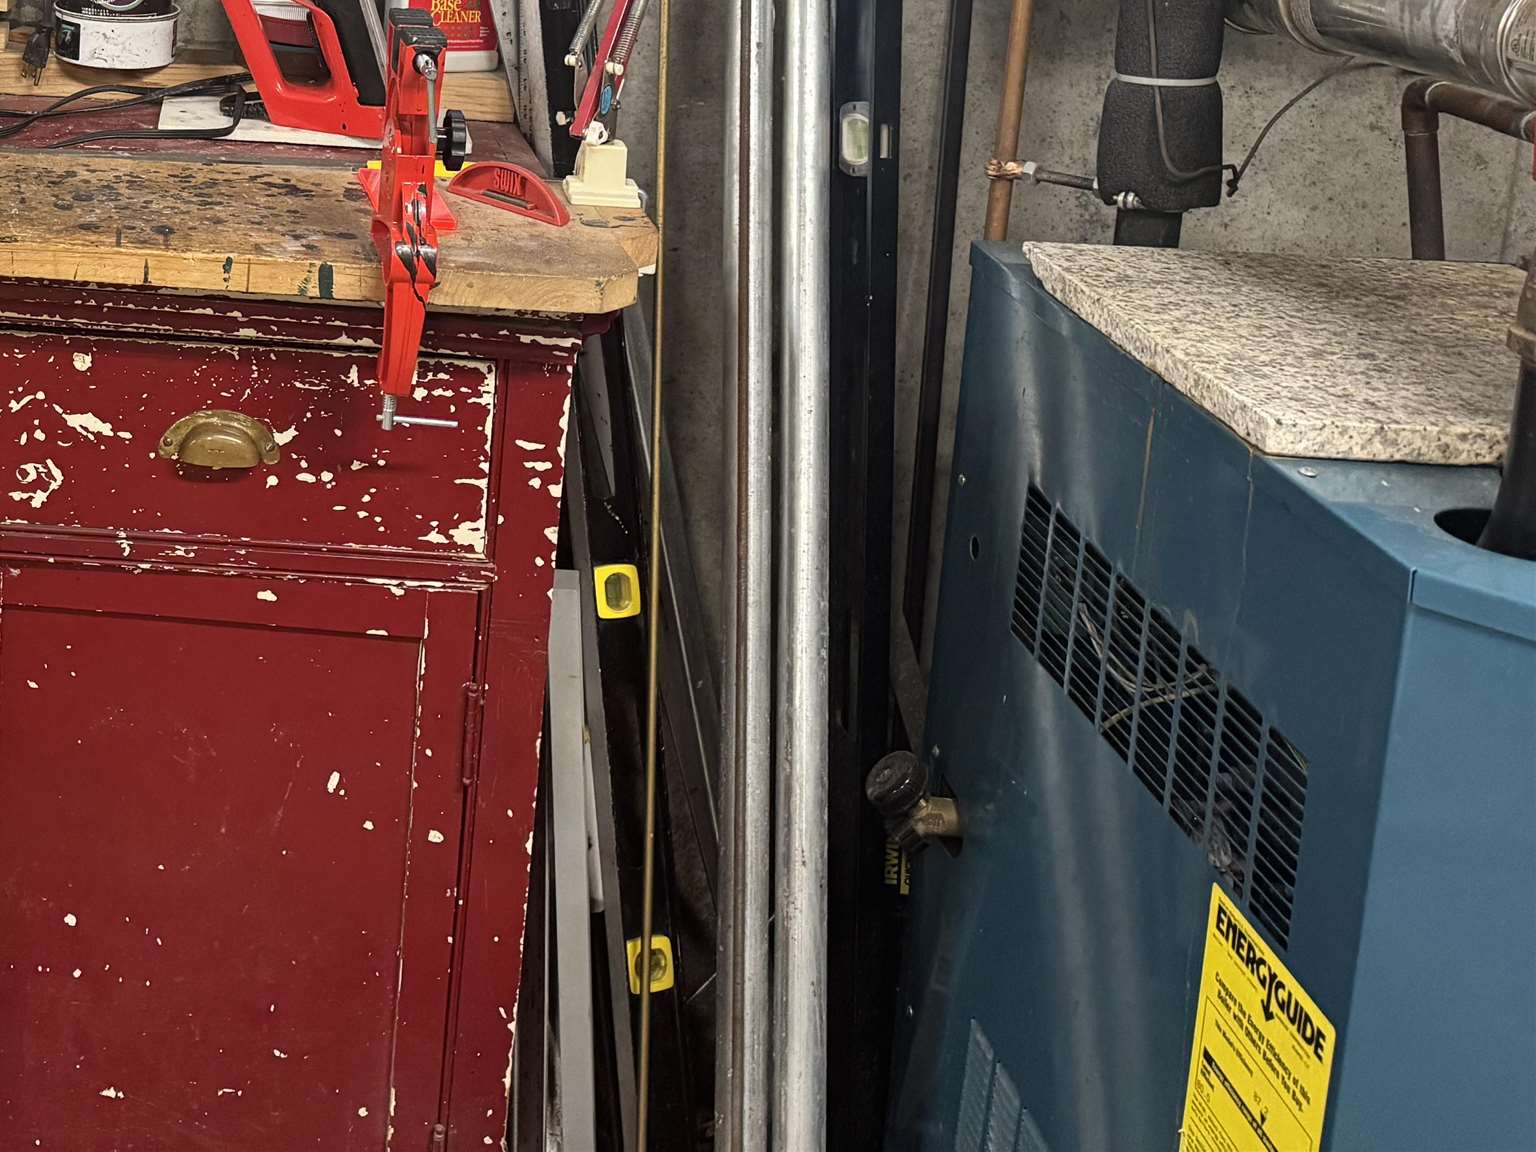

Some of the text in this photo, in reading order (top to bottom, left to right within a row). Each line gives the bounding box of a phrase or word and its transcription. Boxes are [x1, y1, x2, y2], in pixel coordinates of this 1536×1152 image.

[431, 10, 482, 27] CLEANER
[495, 168, 522, 197] SWIX
[1216, 903, 1326, 1064] ENERGYGUIDE
